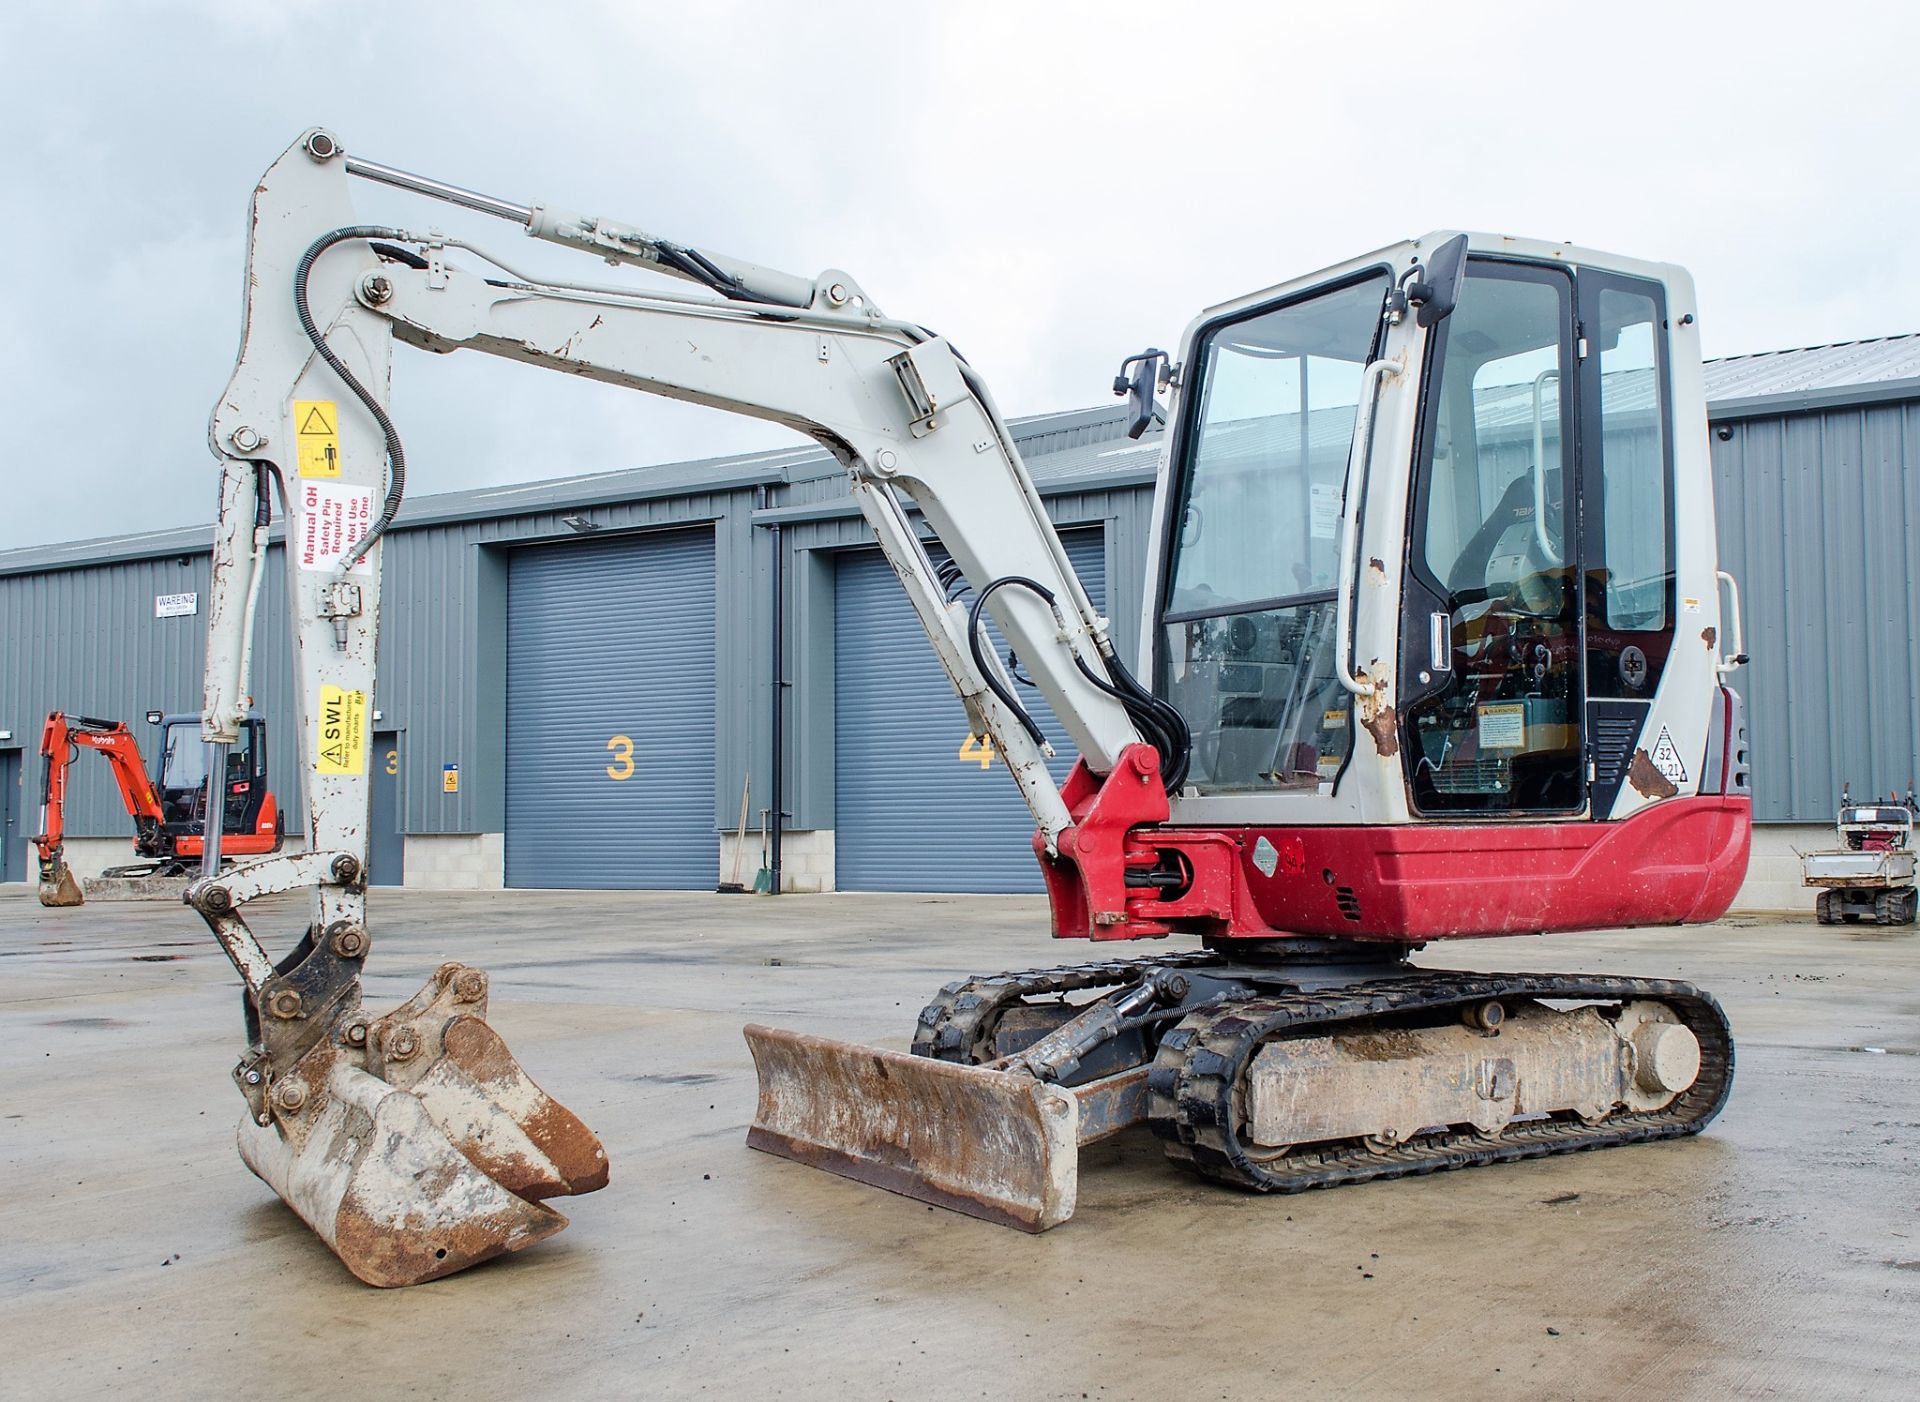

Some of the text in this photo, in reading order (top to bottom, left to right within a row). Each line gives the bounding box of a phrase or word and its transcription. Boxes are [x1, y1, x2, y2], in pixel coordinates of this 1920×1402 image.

[304, 487, 318, 564] Manual QH
[321, 499, 332, 555] Safety Pin
[332, 503, 343, 553] Required
[349, 499, 358, 520] Use
[347, 523, 357, 542] Not
[357, 496, 369, 565] Wout One
[158, 594, 194, 606] WAREING
[325, 695, 342, 740] SWL
[345, 694, 353, 742] manufacturers
[91, 735, 115, 745] Kubota
[607, 735, 635, 780] 3
[959, 731, 995, 769] 4
[1659, 748, 1671, 760] 32
[386, 750, 398, 775] 3
